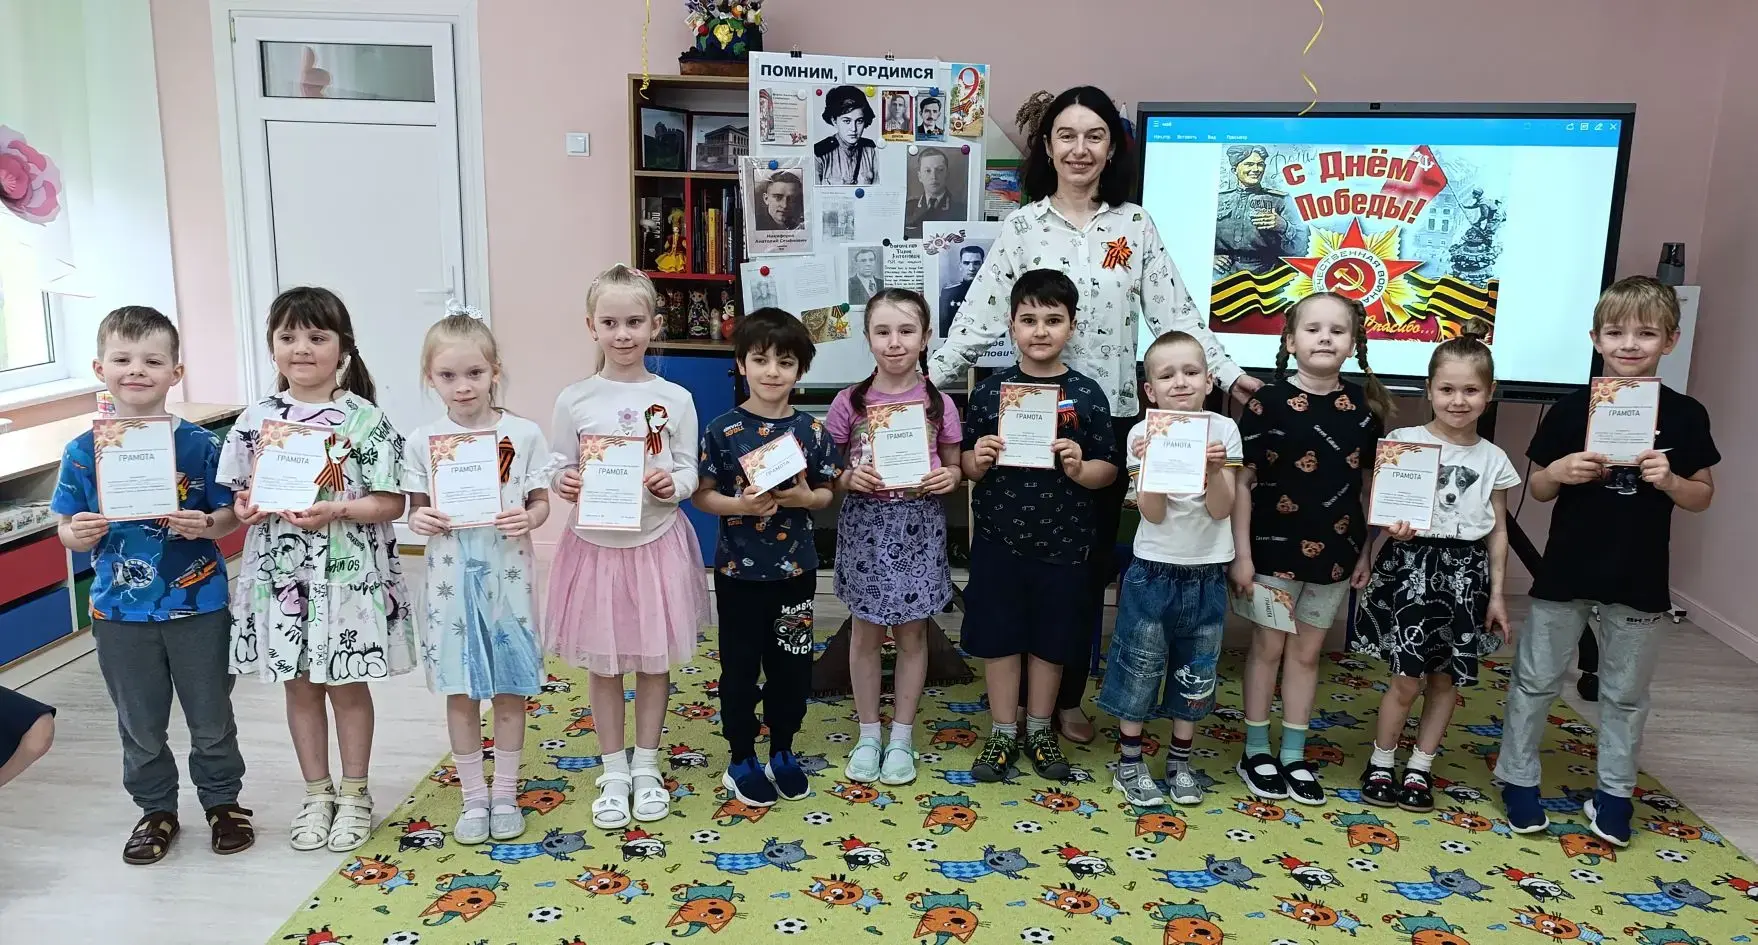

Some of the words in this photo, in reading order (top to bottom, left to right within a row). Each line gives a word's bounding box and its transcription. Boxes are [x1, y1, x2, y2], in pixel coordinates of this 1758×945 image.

[760, 64, 838, 82] ПОМНИМ,
[848, 65, 933, 79] ГОРДИМСЯ
[957, 66, 981, 102] 9
[1319, 148, 1419, 184] Днём
[1294, 188, 1427, 225] Победы!
[1016, 412, 1043, 421] ГРАМОТА
[1608, 409, 1640, 417] ГРАМОТА
[886, 431, 913, 441] ГРАМОТА
[1162, 440, 1192, 449] ГРАМОТА
[118, 452, 155, 462] ГРАМОТА
[277, 454, 309, 465] ГРАМОТА
[450, 464, 482, 474] ГРАМОТА
[598, 467, 628, 476] ГРАМОТА
[765, 460, 790, 477] ГРАМОТА
[1392, 471, 1422, 480] ГРАМОТА
